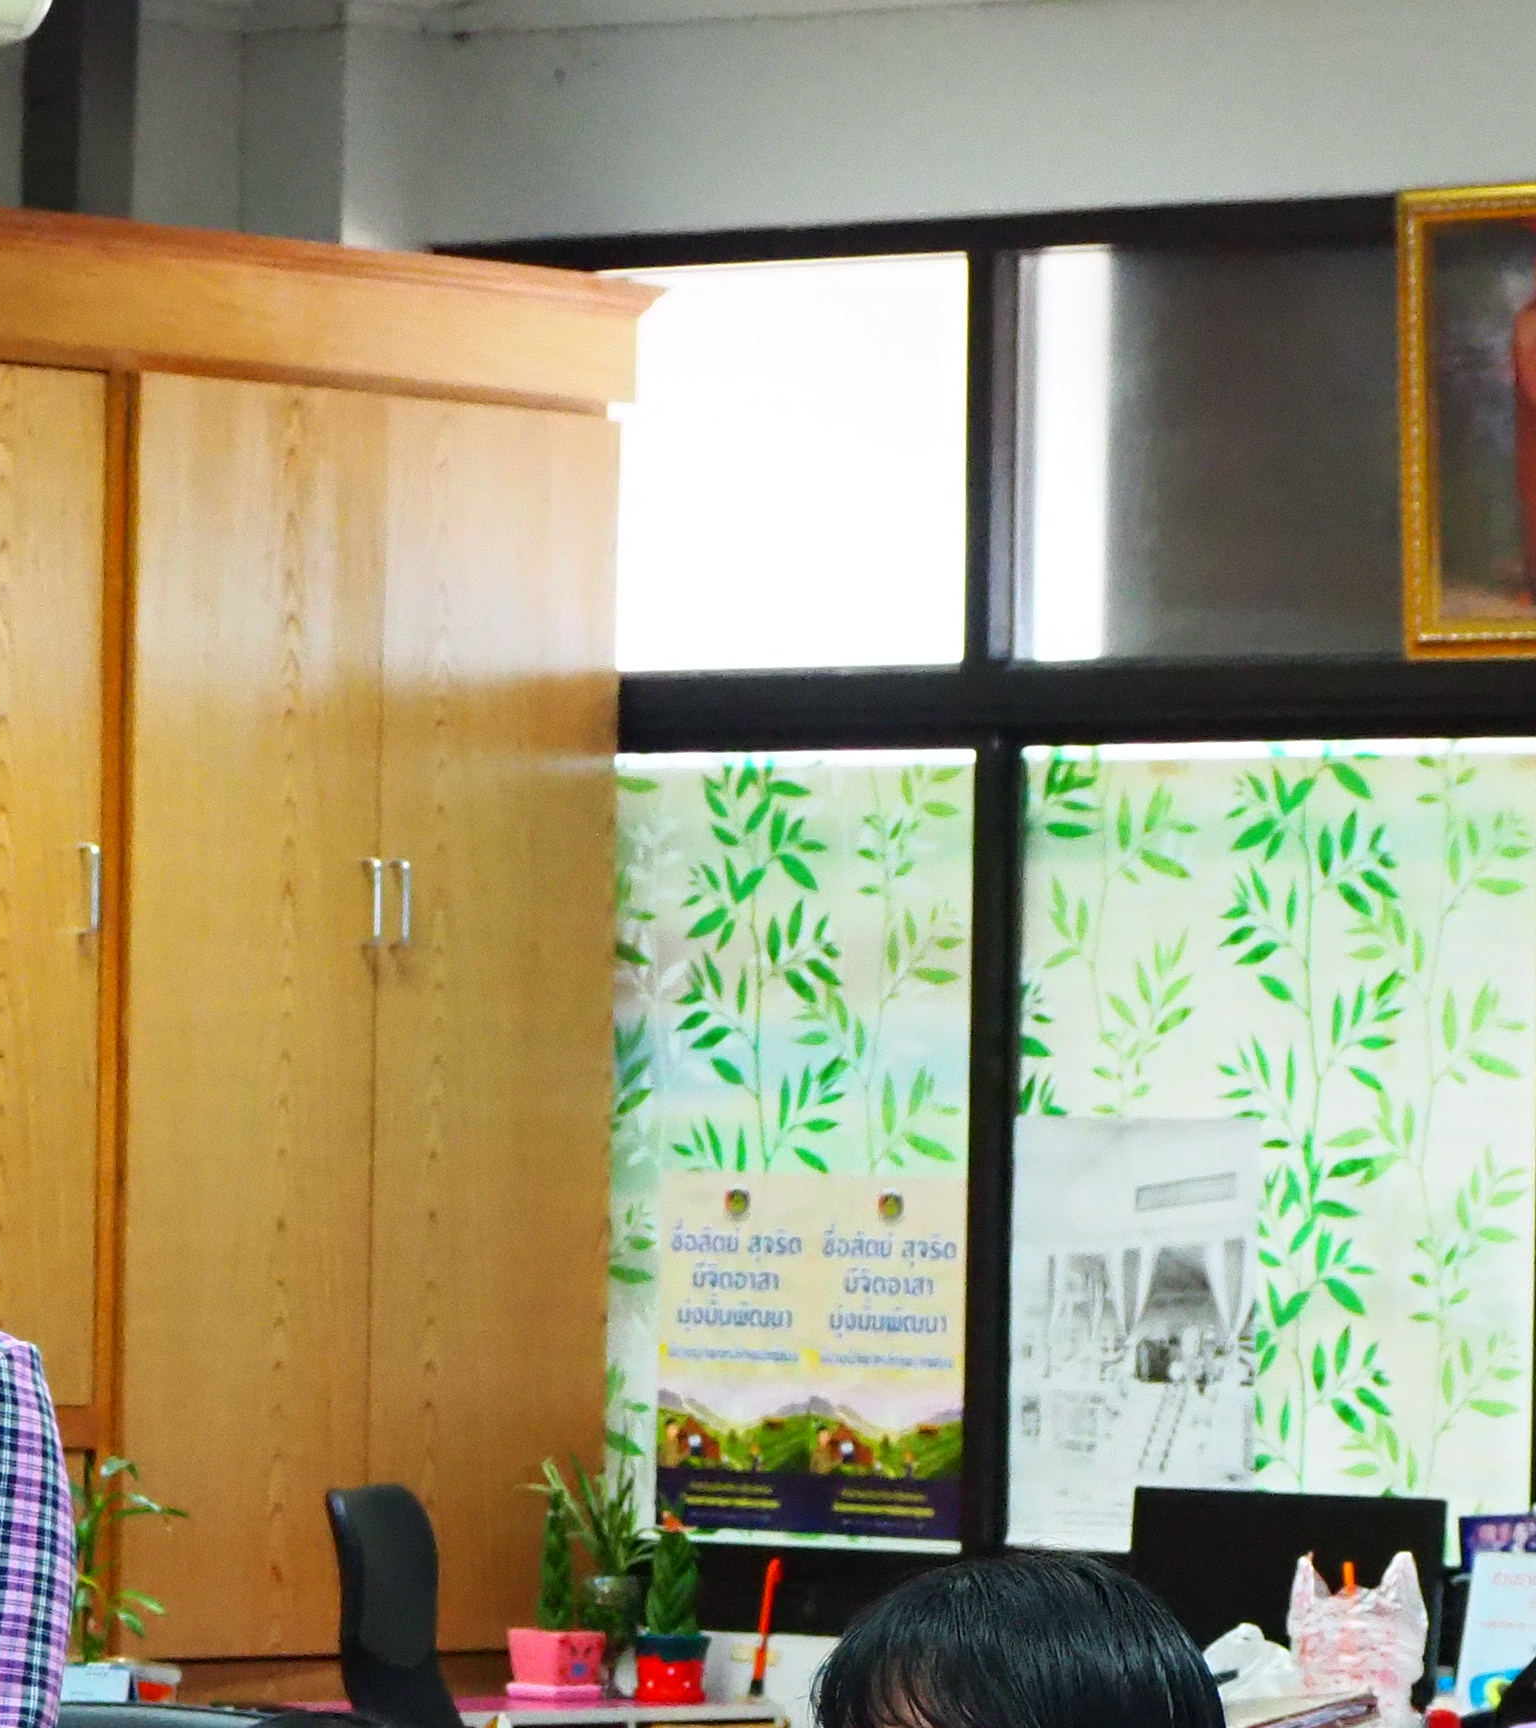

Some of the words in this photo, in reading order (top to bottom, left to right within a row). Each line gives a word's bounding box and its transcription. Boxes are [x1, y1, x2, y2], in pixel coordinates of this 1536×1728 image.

[670, 1217, 740, 1254] ซื่อสัตย์
[746, 1228, 804, 1264] สุจริต
[821, 1223, 894, 1260] ซื่อสัตย์
[901, 1233, 959, 1269] สุจริต
[692, 1261, 781, 1292] มีจิตอาสา
[843, 1266, 937, 1298] มีจิตอาสา
